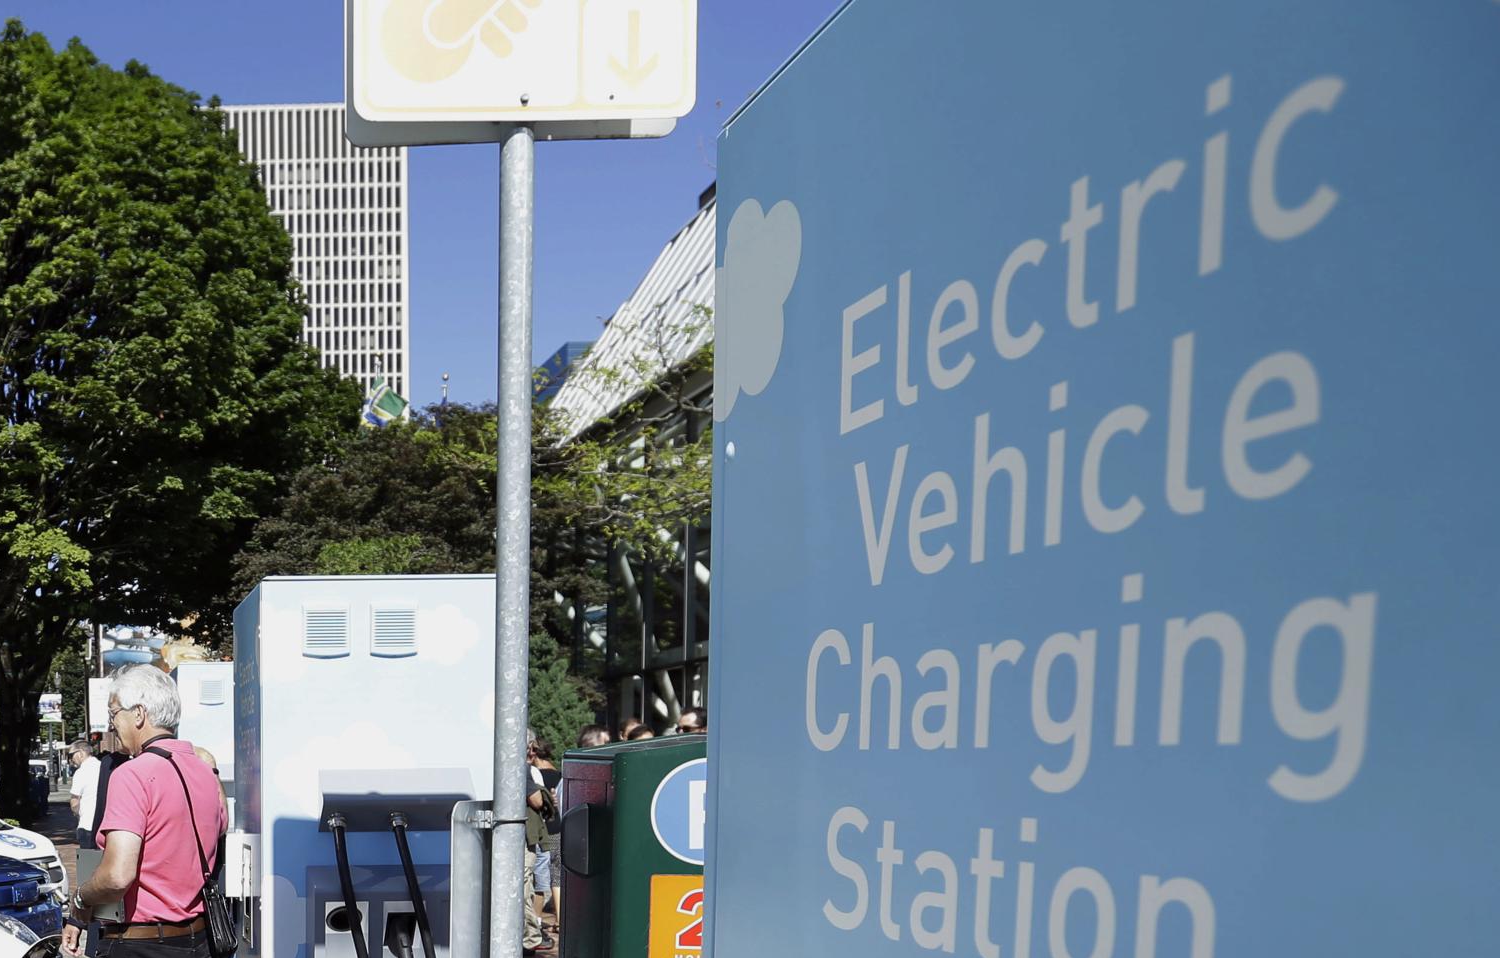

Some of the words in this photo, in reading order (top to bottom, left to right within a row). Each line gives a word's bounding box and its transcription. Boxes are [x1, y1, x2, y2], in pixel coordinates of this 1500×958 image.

[840, 73, 1346, 436] Electric
[854, 332, 1321, 587] Vehicle
[805, 573, 1377, 802] Charging
